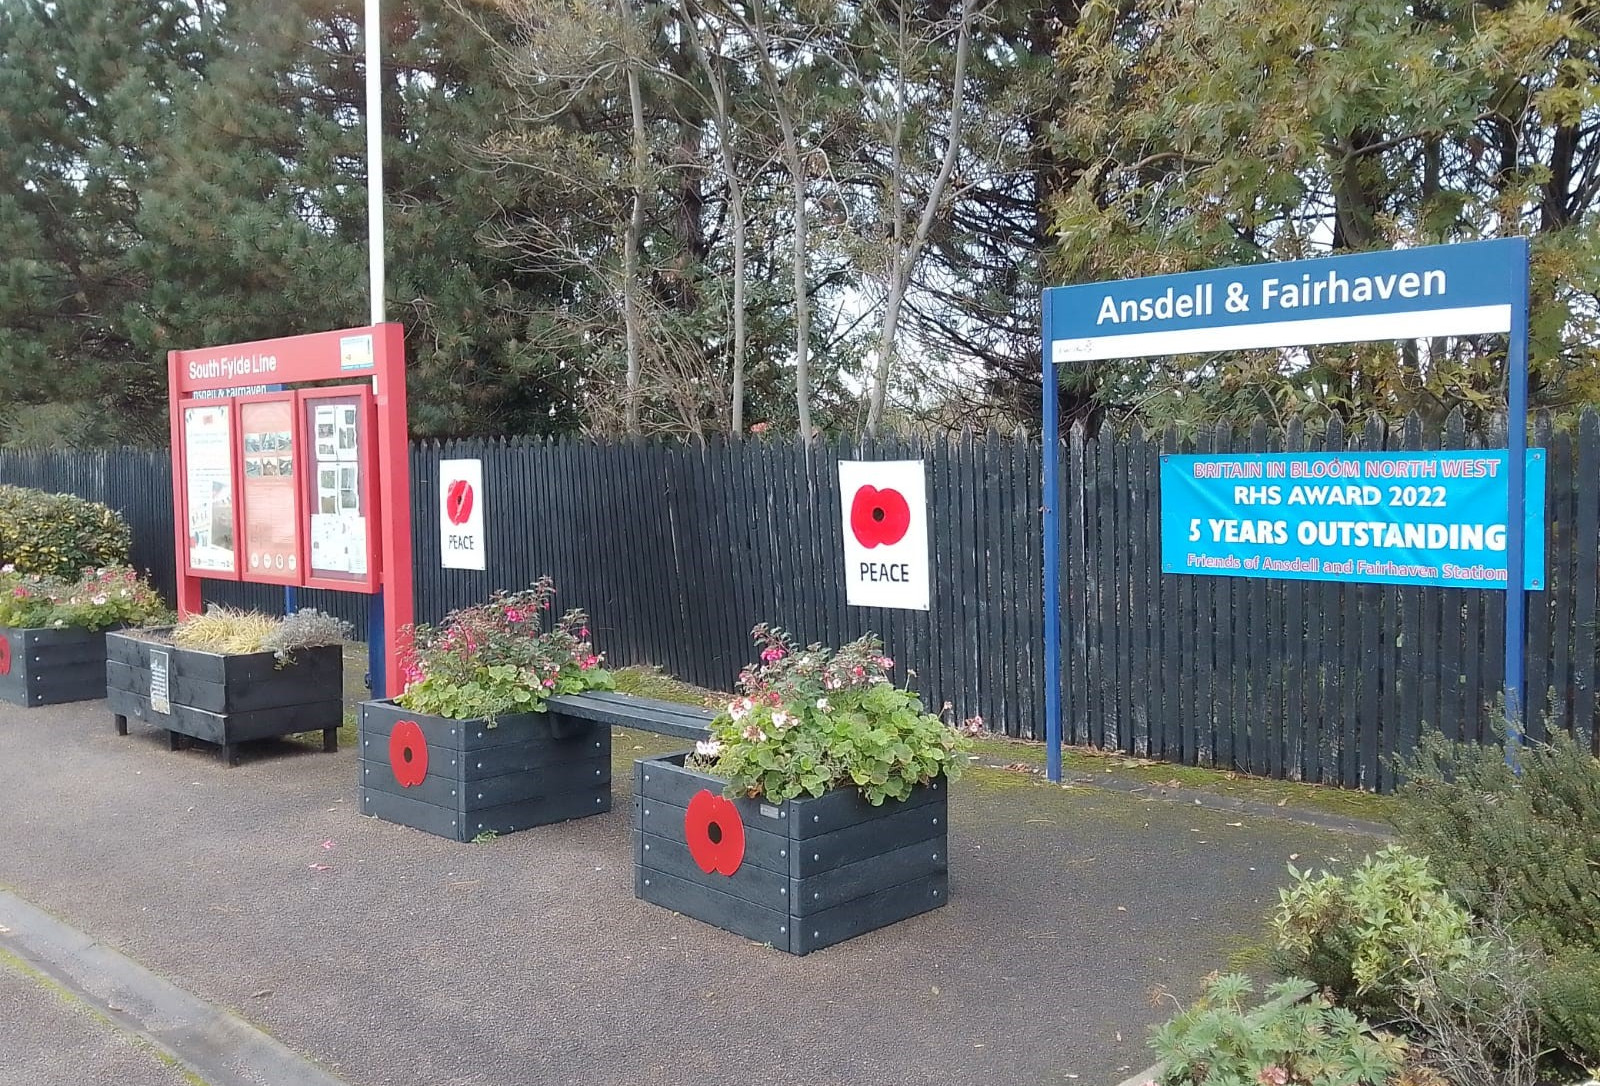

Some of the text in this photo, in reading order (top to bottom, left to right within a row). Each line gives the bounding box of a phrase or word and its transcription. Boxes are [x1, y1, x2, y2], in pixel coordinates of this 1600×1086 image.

[1095, 269, 1447, 326] Ansdell & Fairhaven
[189, 354, 277, 379] South Fylde Line
[1193, 458, 1502, 479] BRITAIN IN BLOOM NORTH WEST
[1233, 485, 1447, 507] RHS AWARD 2022
[449, 535, 475, 550] PEACE
[1188, 518, 1507, 551] 5 YEARS OUTSTANDING
[860, 562, 909, 582] PEACE
[1186, 552, 1508, 581] Friends of Ansdell and Fairhaven Station
